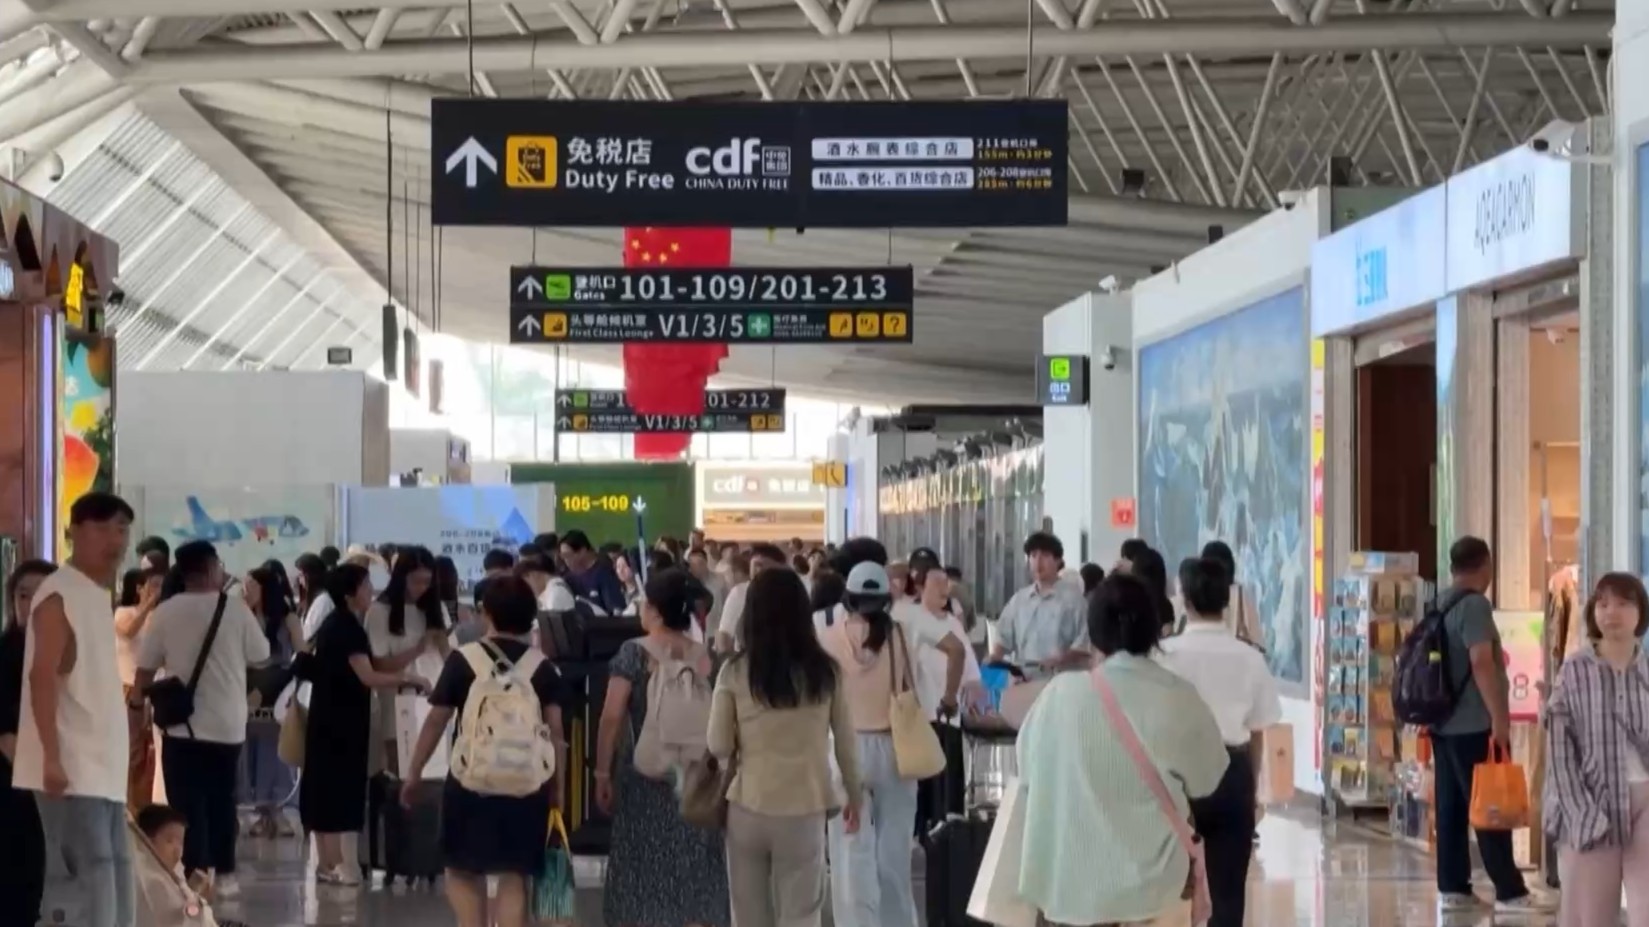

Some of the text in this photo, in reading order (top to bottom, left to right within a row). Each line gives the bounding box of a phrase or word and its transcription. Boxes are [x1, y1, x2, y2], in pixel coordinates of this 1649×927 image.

[566, 137, 653, 164] 免税店
[685, 137, 761, 175] cdf
[565, 170, 675, 193] Duty Free
[685, 178, 724, 190] CHINA
[727, 178, 760, 190] DUTY
[574, 291, 605, 300] Gates
[620, 274, 887, 300] 101-109/201-213
[658, 314, 744, 338] V1/3/5
